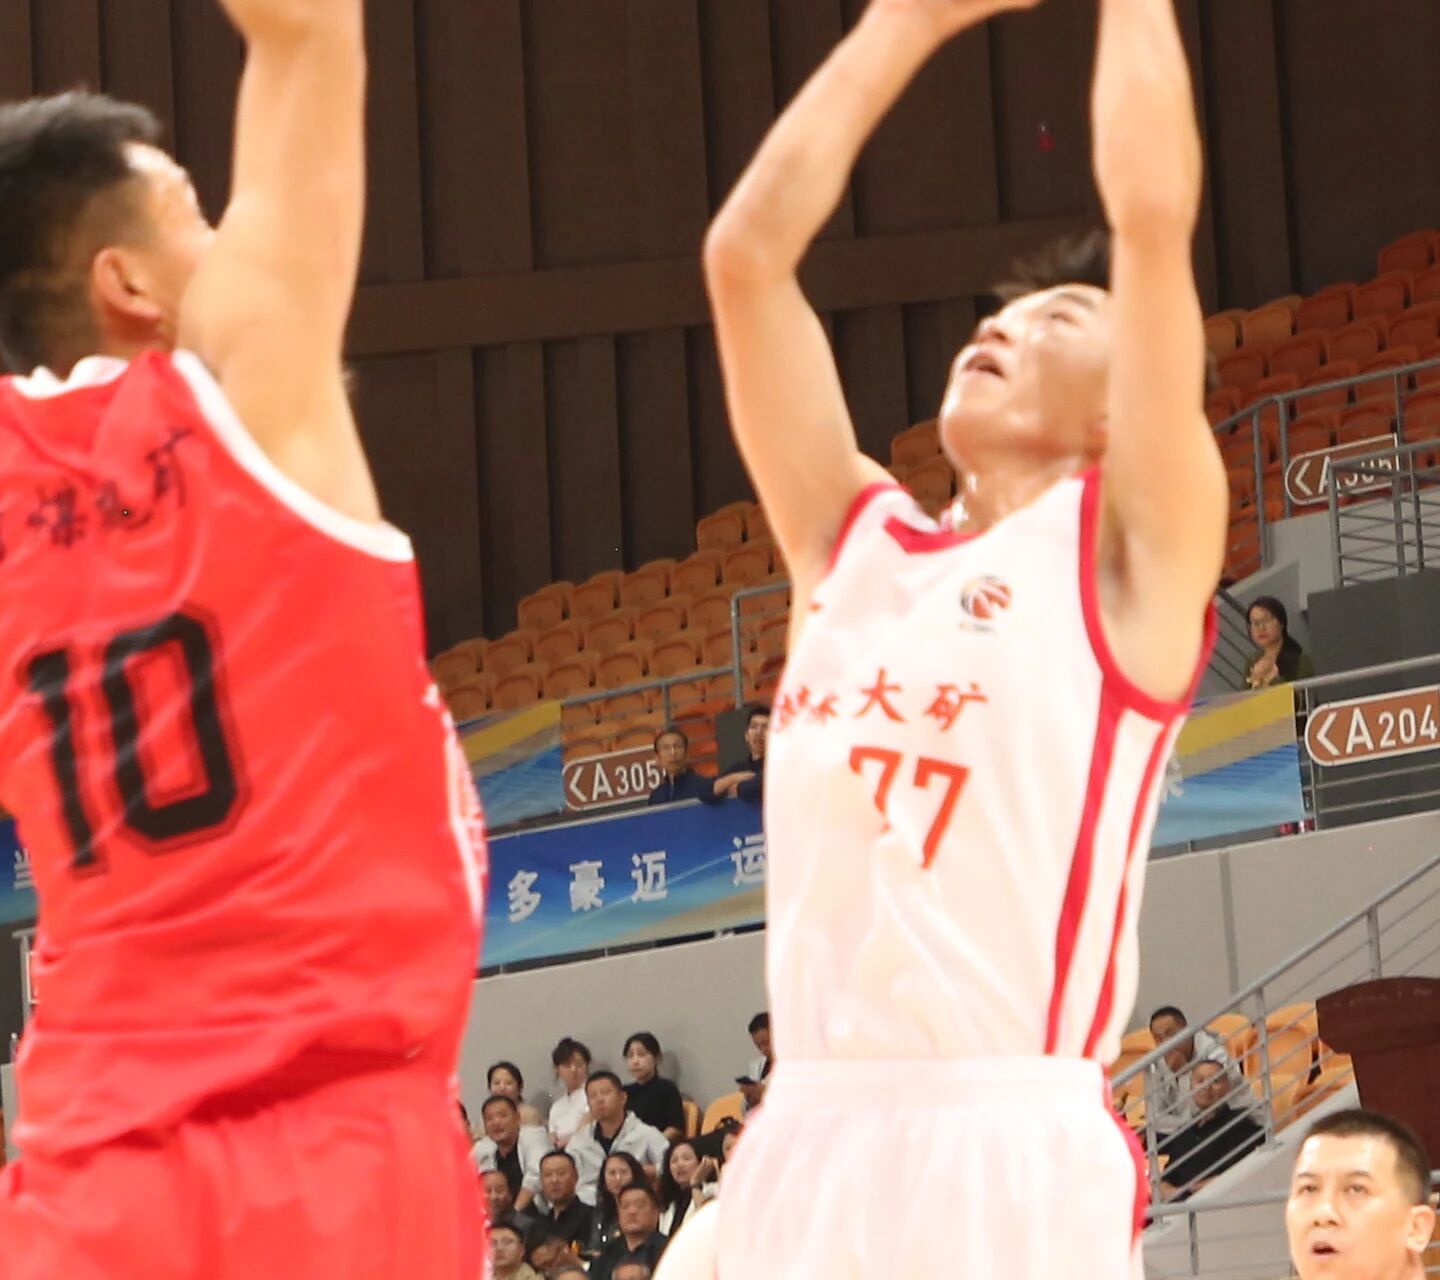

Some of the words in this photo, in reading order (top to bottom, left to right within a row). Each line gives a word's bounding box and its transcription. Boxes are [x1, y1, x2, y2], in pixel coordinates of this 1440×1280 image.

[16, 600, 250, 880] 10
[1345, 705, 1438, 754] A204
[592, 759, 661, 801] A305
[848, 745, 969, 870] 77
[507, 851, 669, 922] 多豪迈
